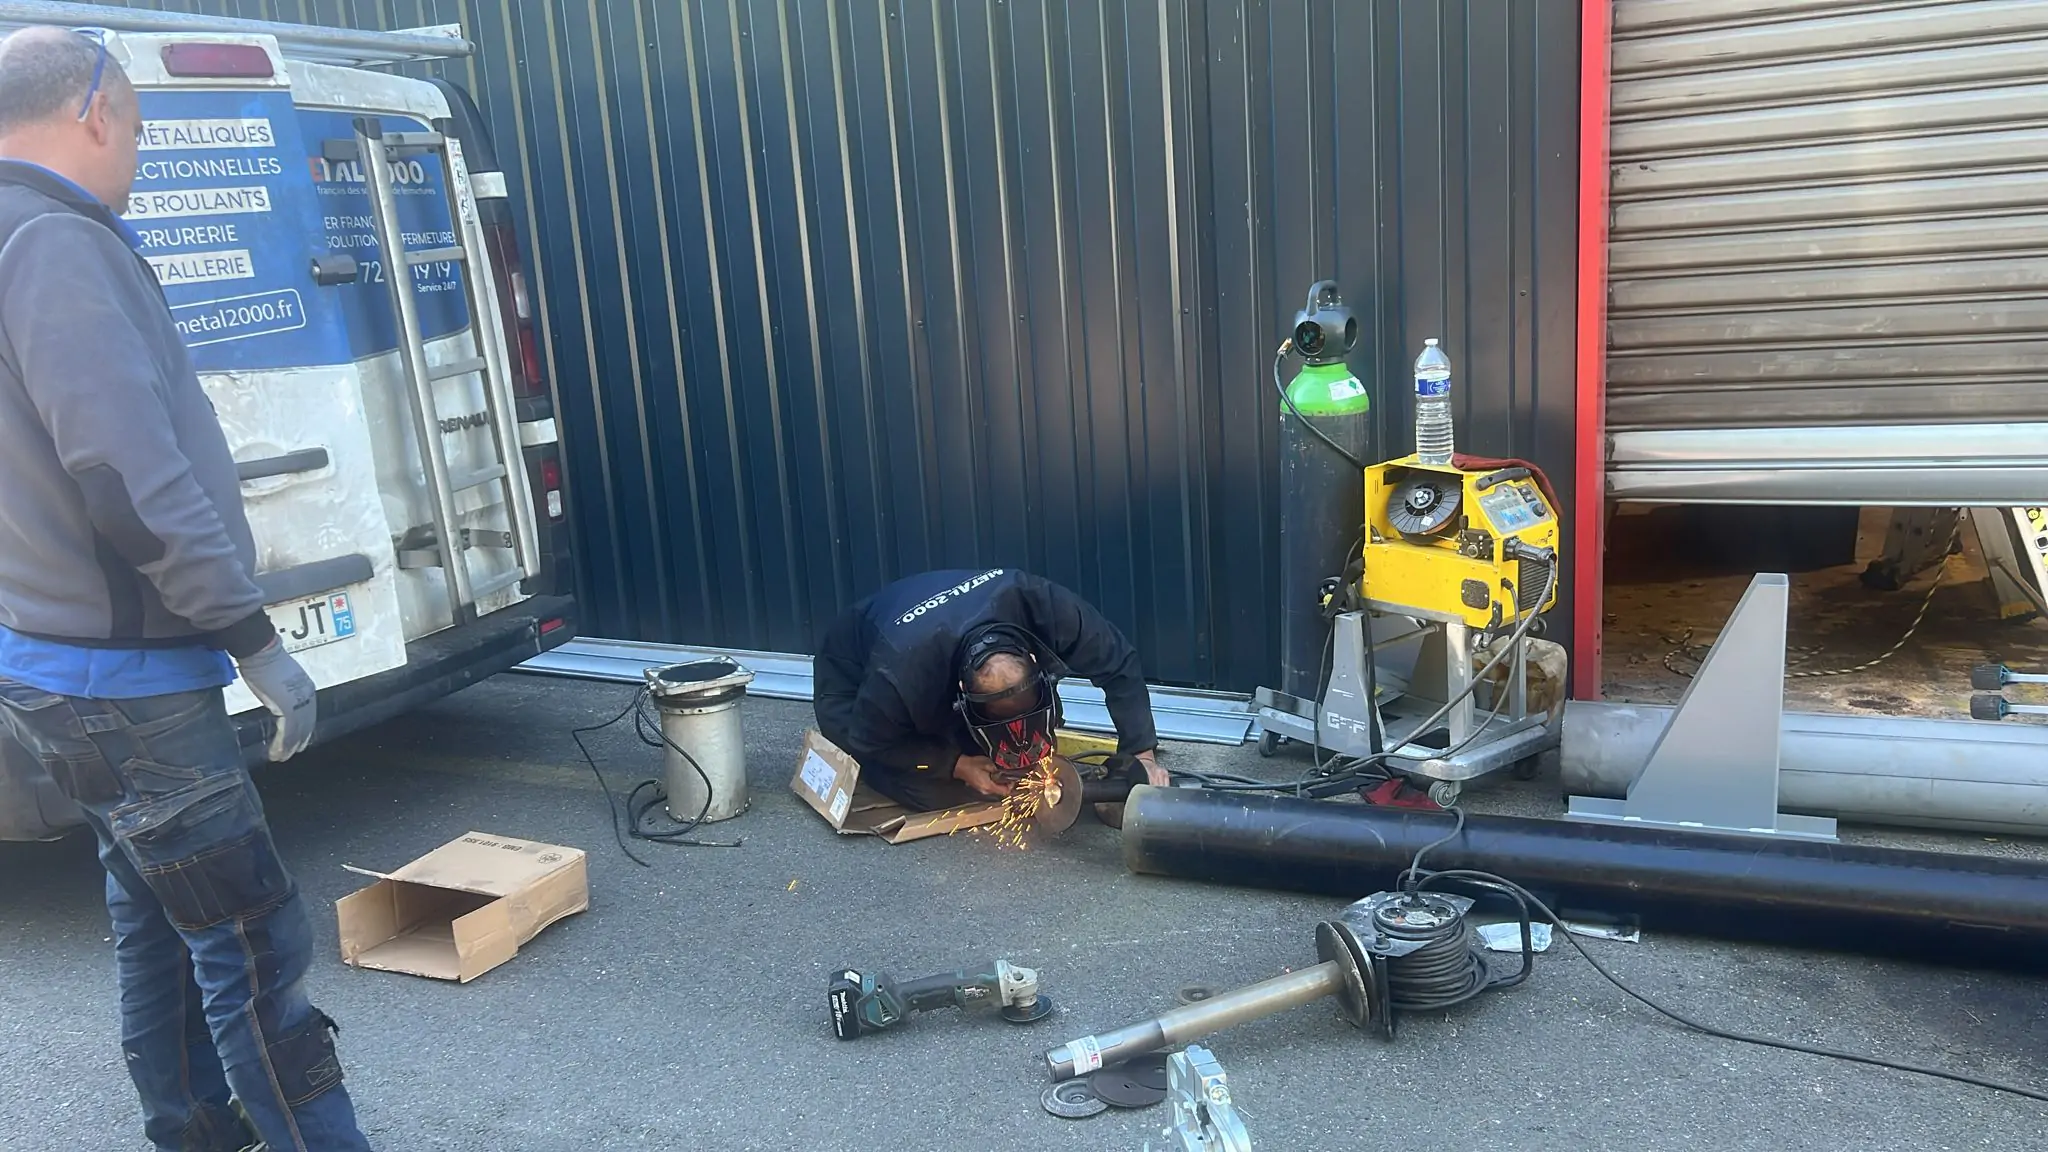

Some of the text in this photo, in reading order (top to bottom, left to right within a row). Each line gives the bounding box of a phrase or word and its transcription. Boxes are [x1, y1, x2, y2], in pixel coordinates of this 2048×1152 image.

[153, 190, 266, 214] ROULANTS
[153, 257, 247, 281] TALLERIE
[360, 261, 385, 284] 72
[948, 569, 1004, 596] METAL
[335, 615, 352, 632] 75
